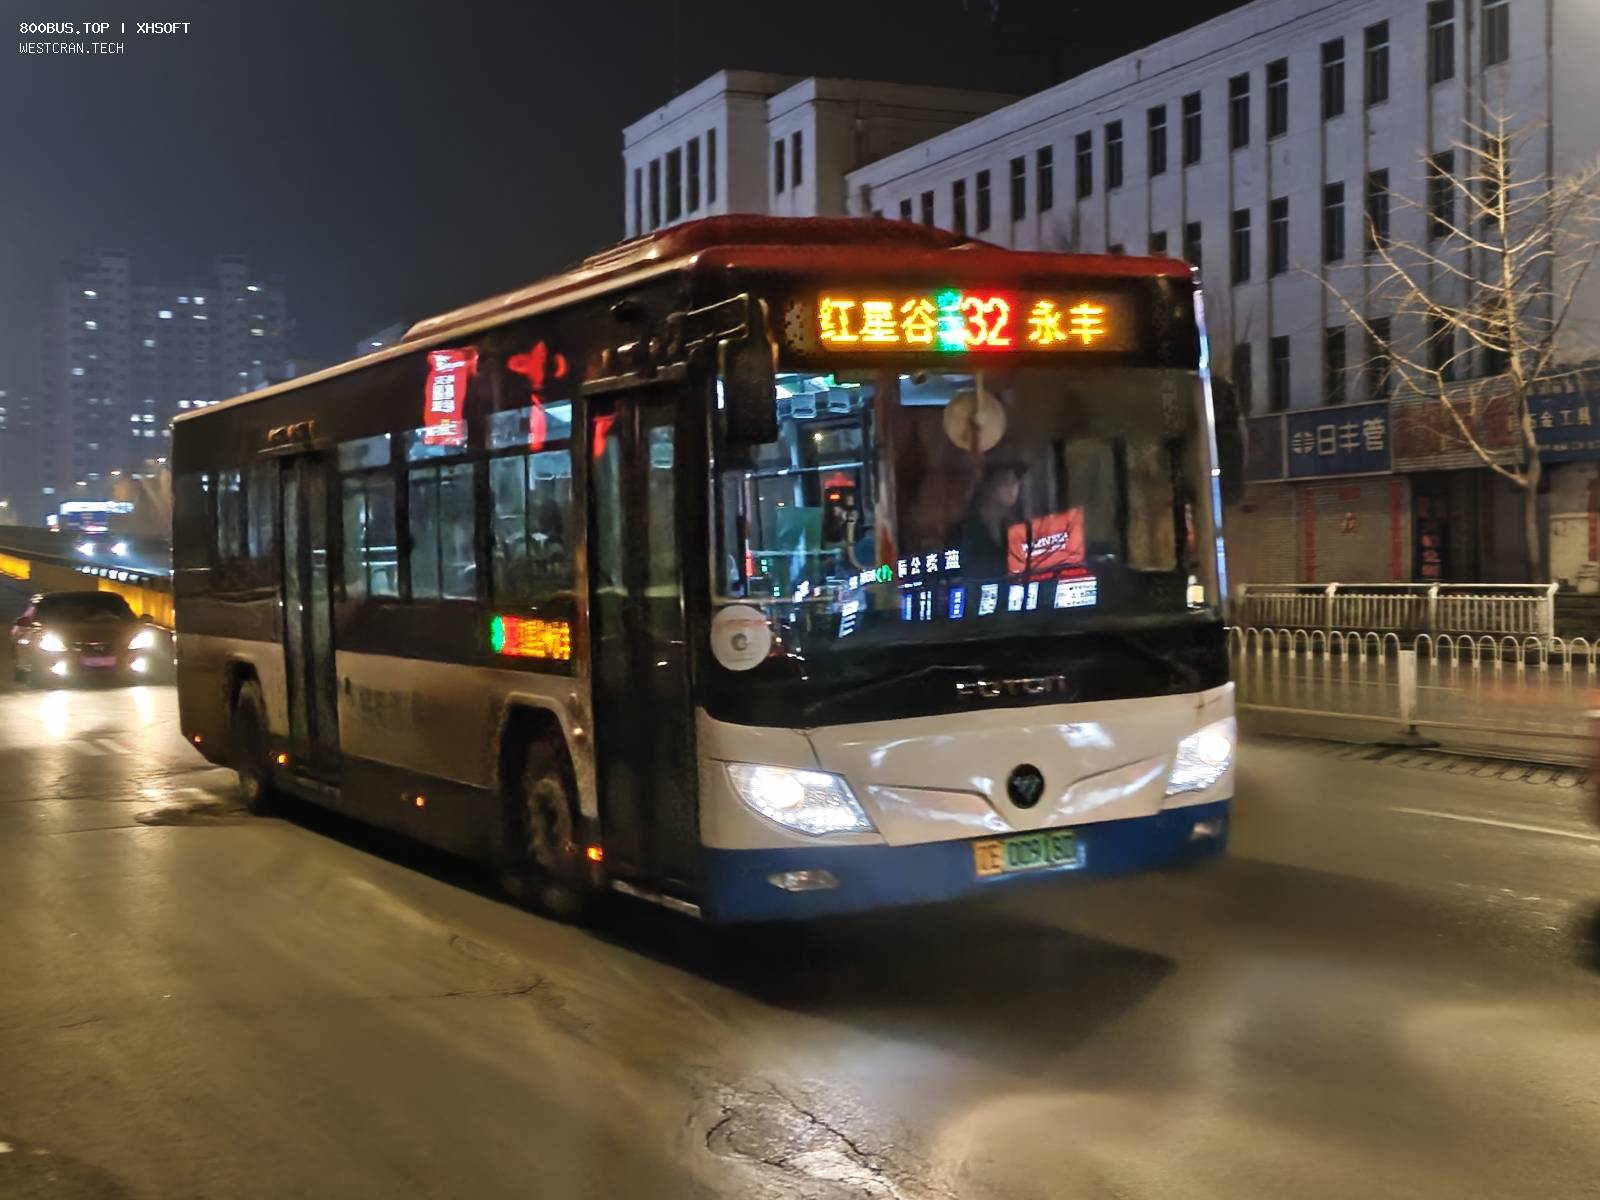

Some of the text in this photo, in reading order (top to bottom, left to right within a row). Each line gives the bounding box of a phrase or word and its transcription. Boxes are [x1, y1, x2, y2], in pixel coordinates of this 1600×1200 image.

[819, 298, 938, 343] 红星谷
[961, 297, 1012, 346] 32
[1028, 300, 1105, 345] 永丰
